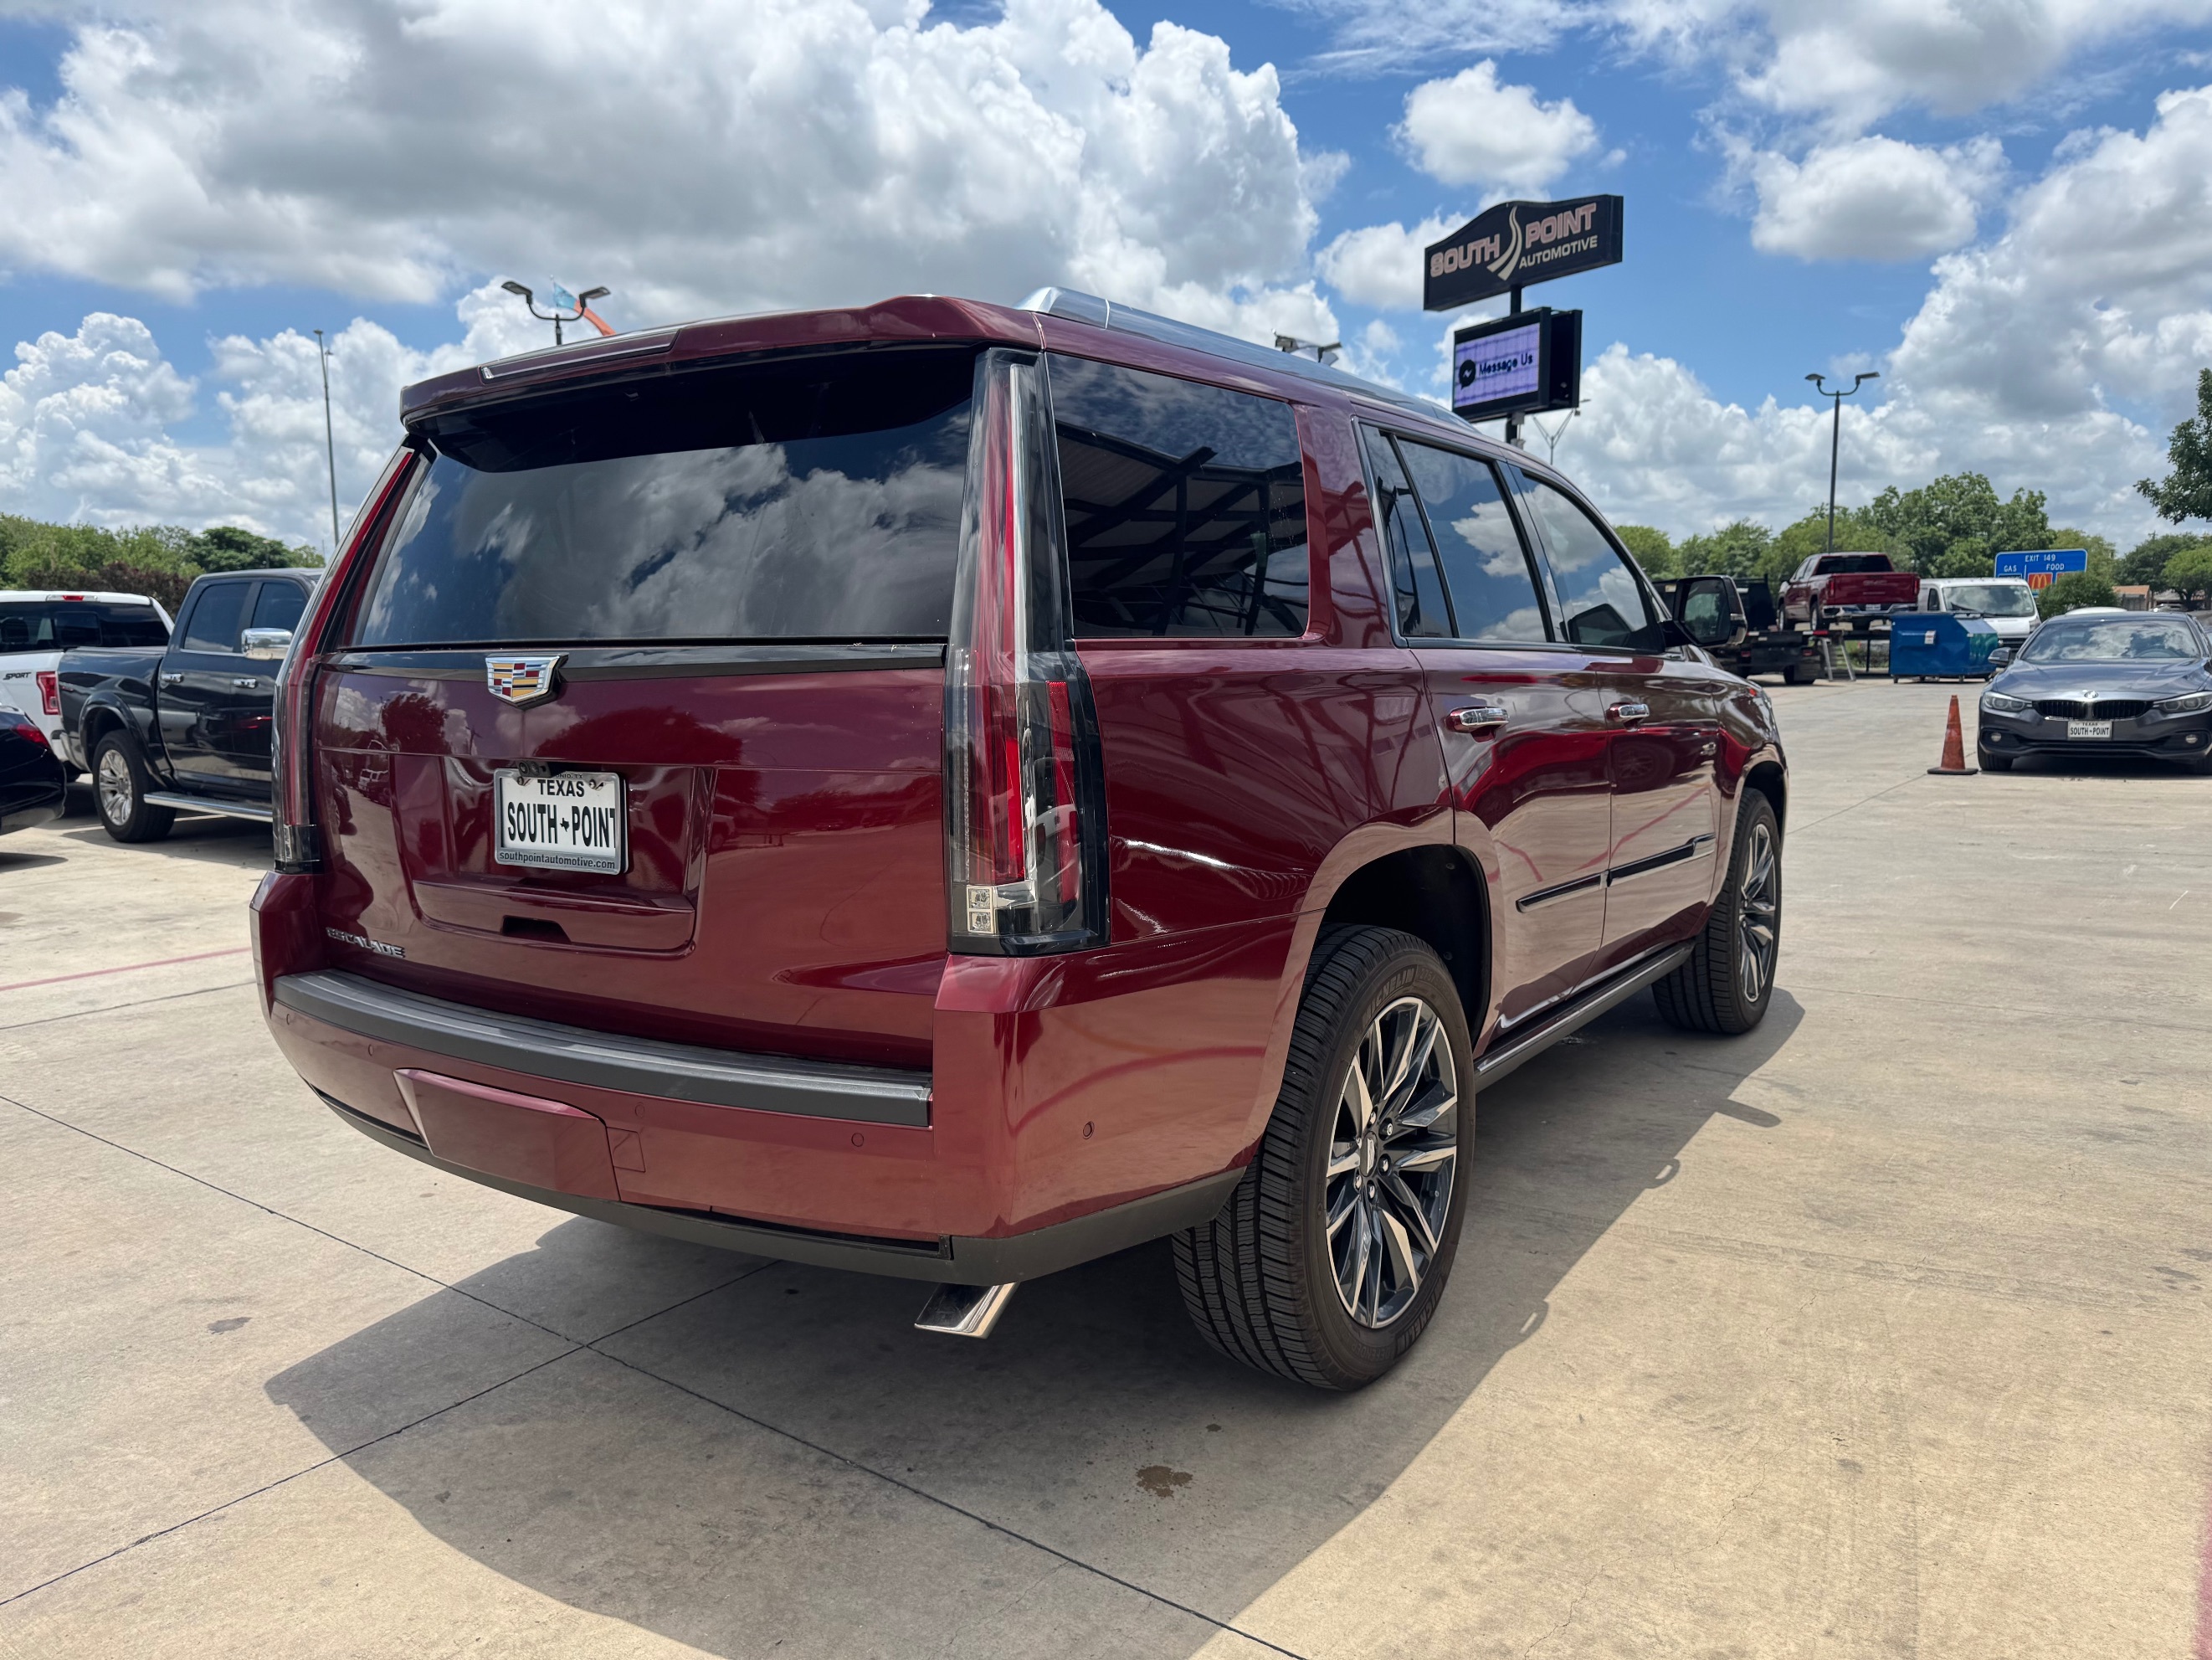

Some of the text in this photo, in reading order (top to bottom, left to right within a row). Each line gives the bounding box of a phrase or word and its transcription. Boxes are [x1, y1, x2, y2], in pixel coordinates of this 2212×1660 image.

[1429, 203, 1597, 278] SOUTH POINT
[1519, 234, 1599, 270] AUTOMOTIVE
[1479, 352, 1533, 376] Message Us
[2044, 553, 2056, 562] 149
[2045, 563, 2065, 571] FOOD
[3, 671, 32, 681] SPORT
[2070, 727, 2110, 736] SOUTH POINT
[537, 779, 585, 797] TEXAS
[507, 801, 616, 849] SOUTH POINT
[500, 852, 615, 870] southpointautomotive.com
[1363, 968, 1414, 1030] MICHELIN
